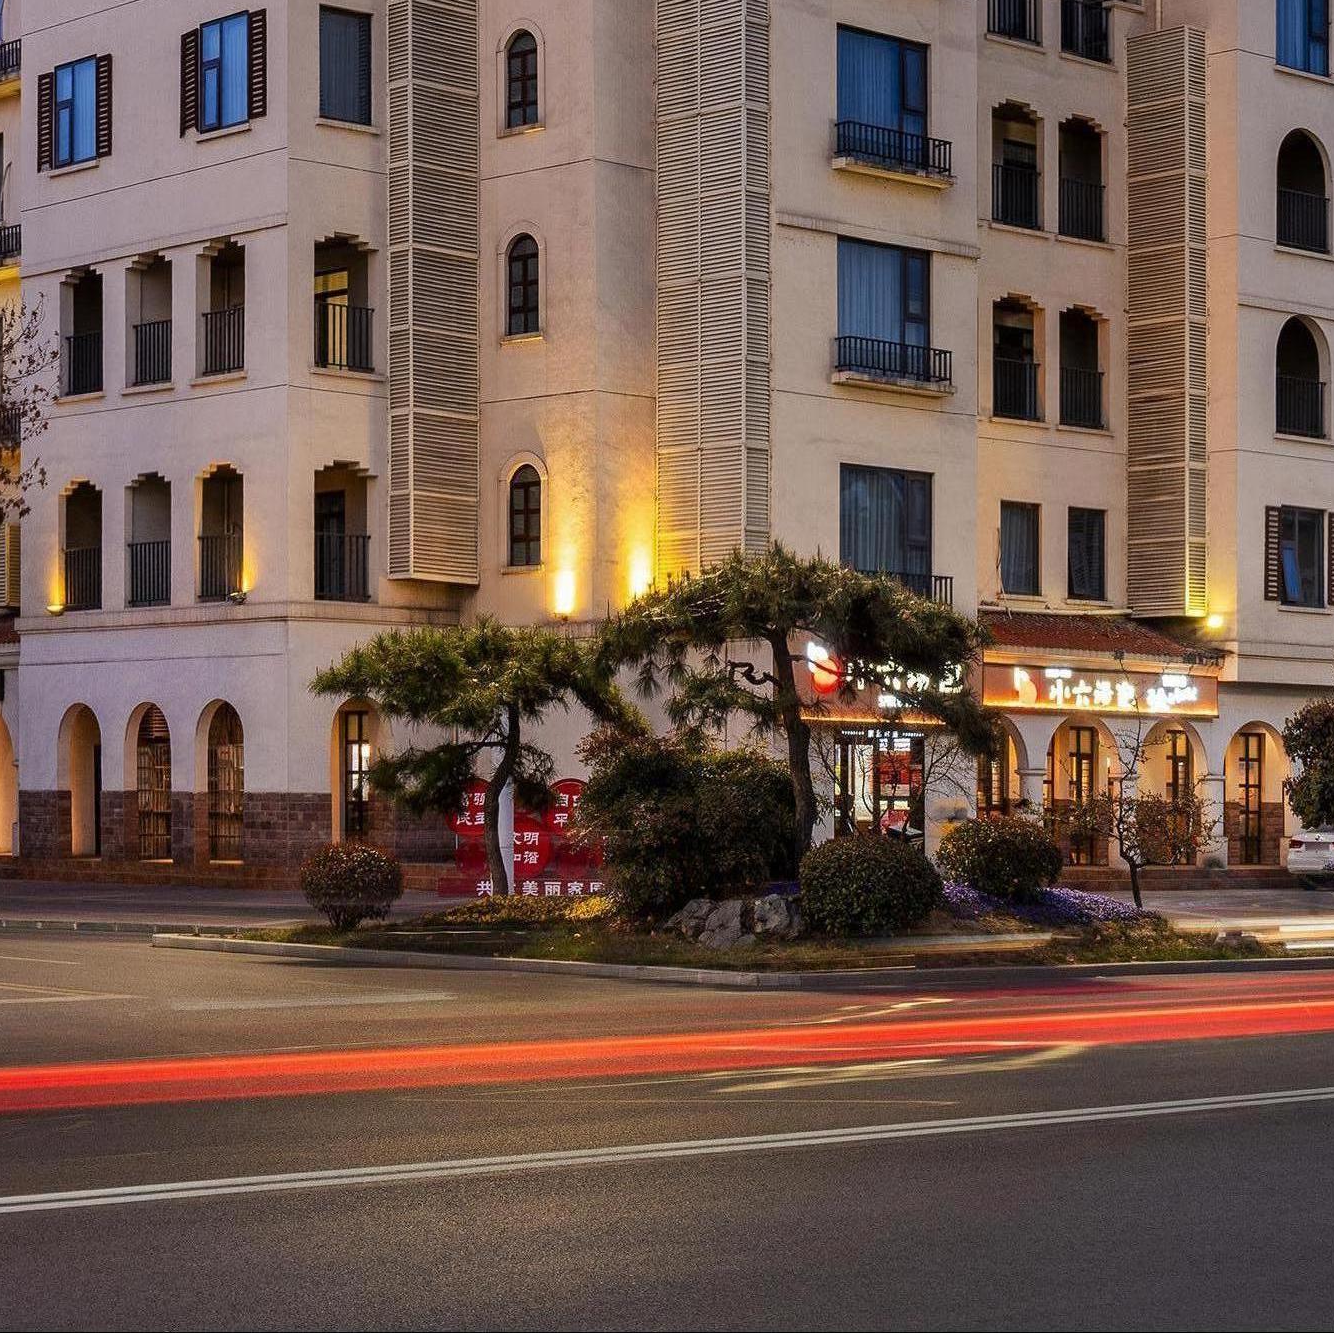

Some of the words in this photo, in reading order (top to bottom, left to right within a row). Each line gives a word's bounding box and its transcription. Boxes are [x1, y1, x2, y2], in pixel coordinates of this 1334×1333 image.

[476, 880, 604, 896] 共美丽家园
